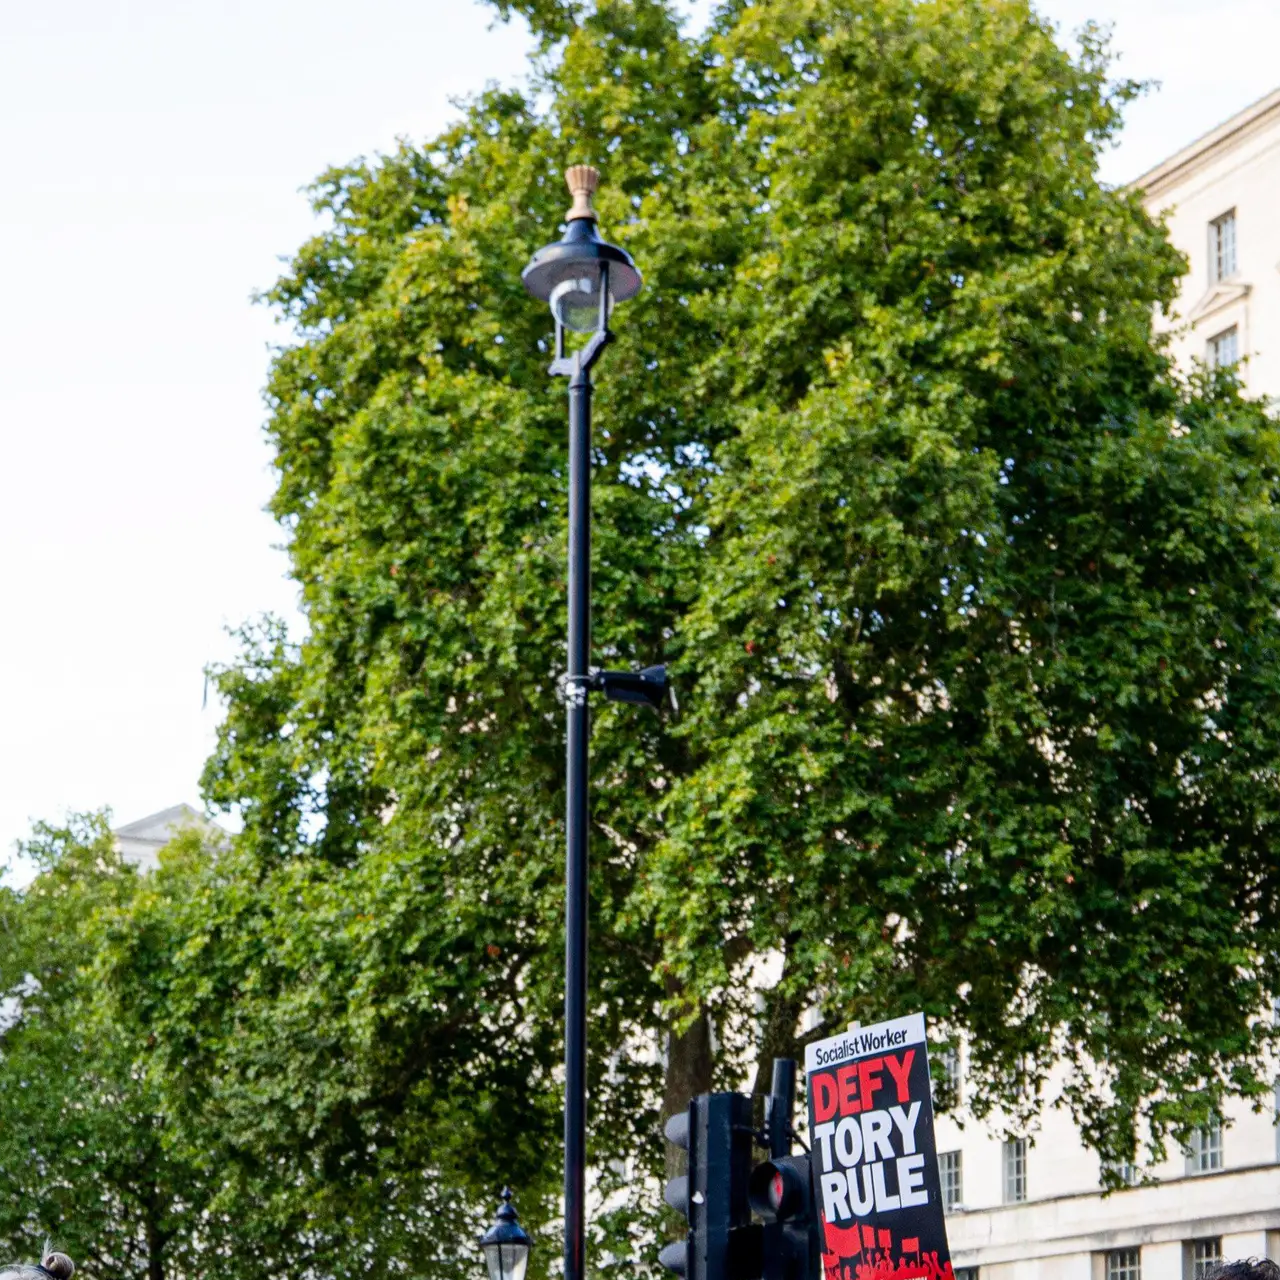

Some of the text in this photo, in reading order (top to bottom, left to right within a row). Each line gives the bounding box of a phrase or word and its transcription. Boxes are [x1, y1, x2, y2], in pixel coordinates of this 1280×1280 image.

[816, 1028, 908, 1066] Socialist Worker
[811, 1050, 916, 1123] DEFY
[814, 1101, 922, 1172] TORY
[821, 1154, 929, 1223] RULE
